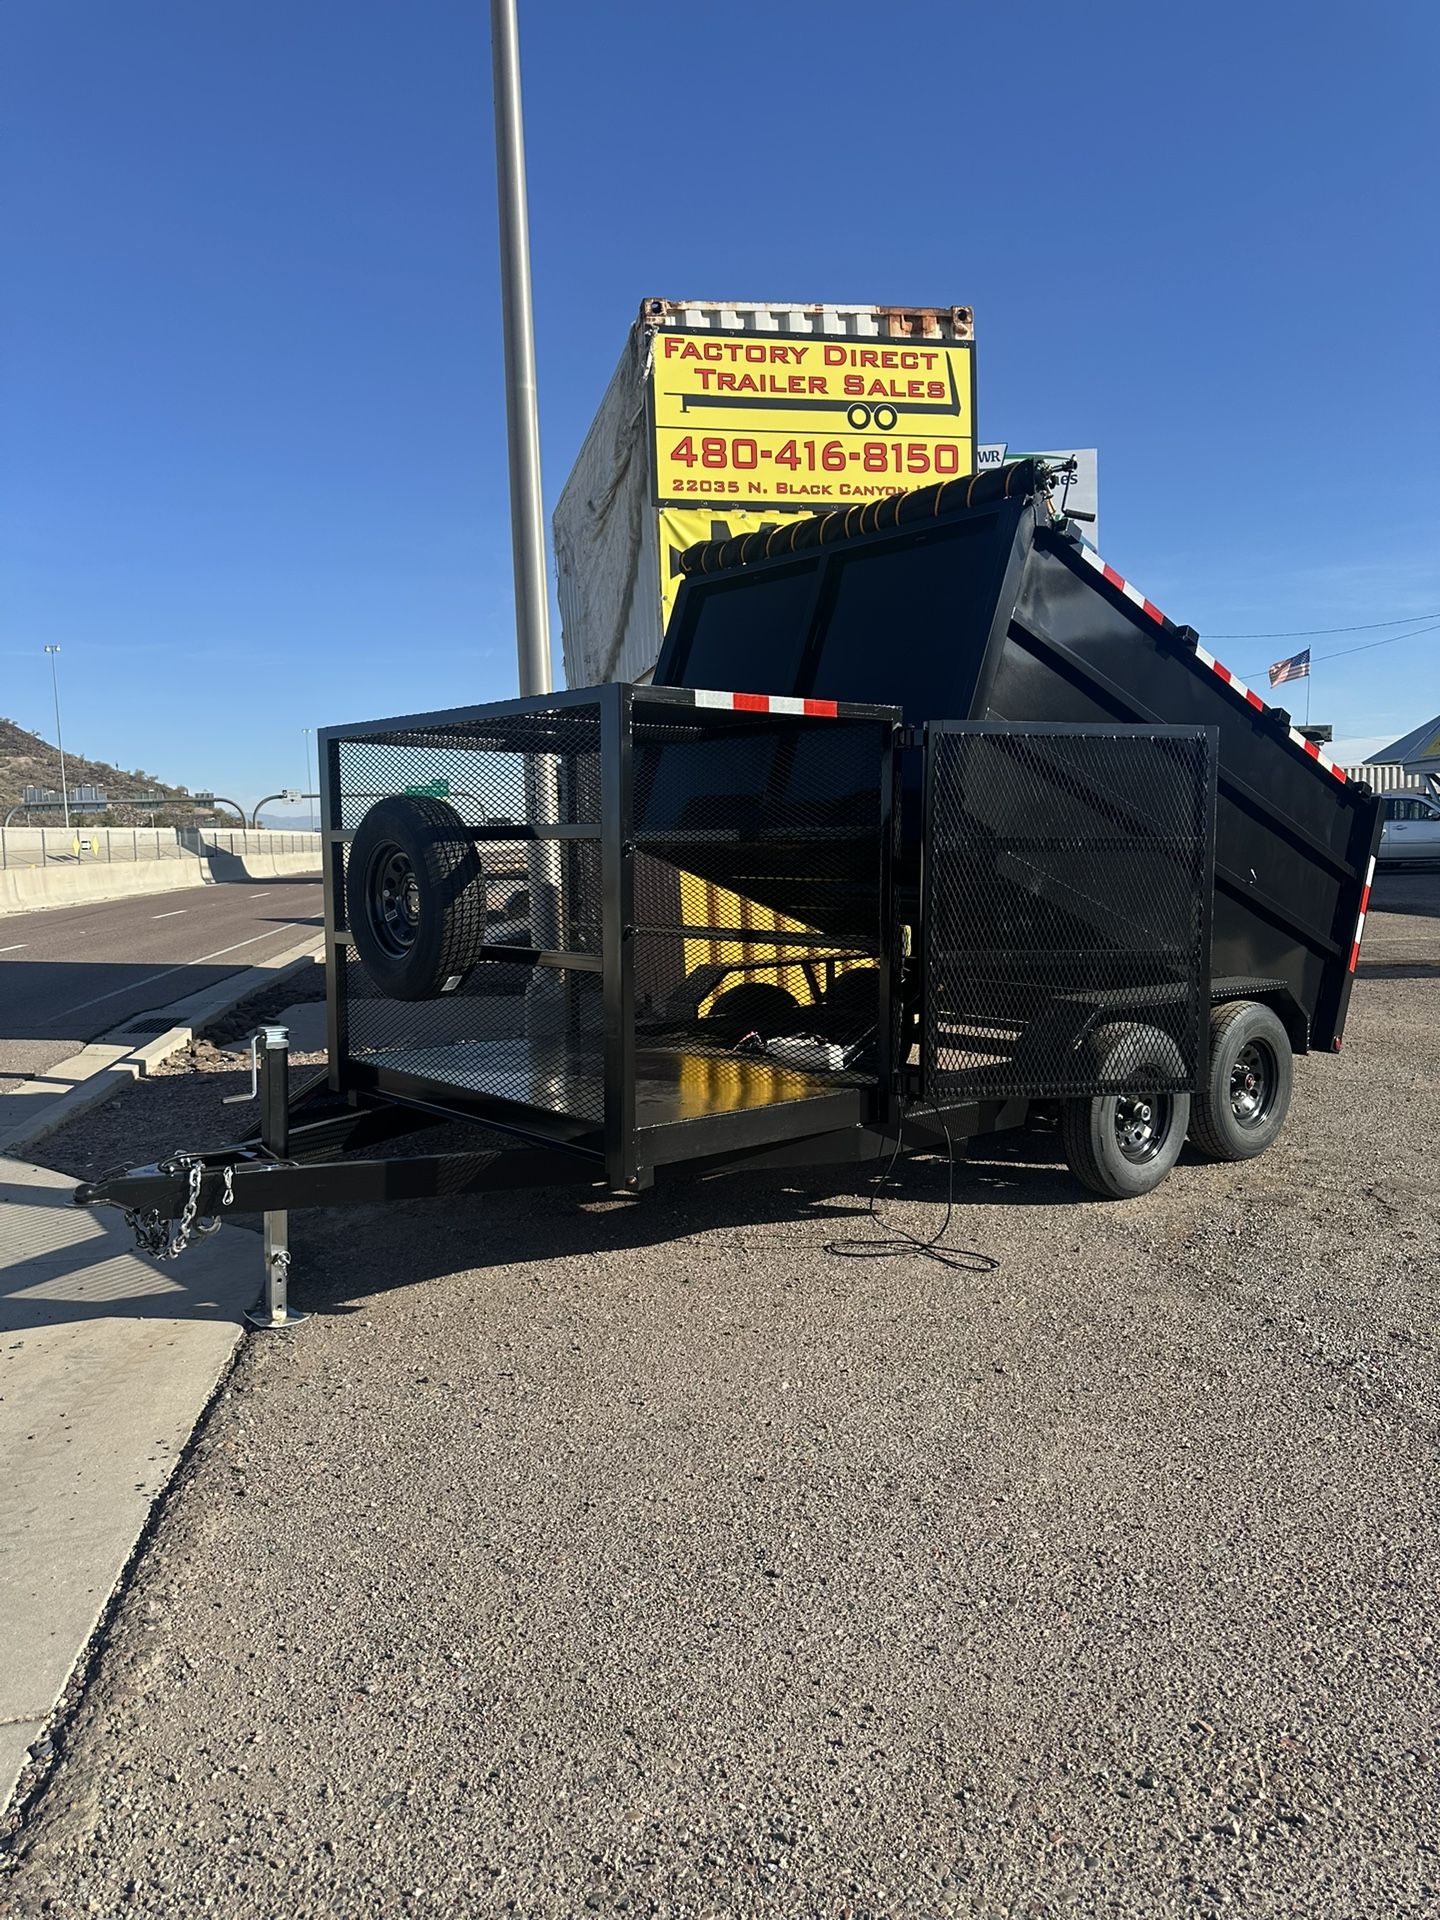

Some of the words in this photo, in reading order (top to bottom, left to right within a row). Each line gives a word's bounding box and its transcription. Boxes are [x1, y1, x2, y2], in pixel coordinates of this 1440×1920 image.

[664, 337, 809, 364] FACTORY
[824, 345, 939, 370] DIRECT
[694, 368, 829, 394] TRAILER
[843, 374, 946, 398] SALES
[670, 436, 959, 474] 480-416-8150
[672, 479, 740, 493] 22035
[748, 482, 768, 494] N.
[776, 482, 833, 495] BLACK
[839, 483, 909, 496] CANYON
